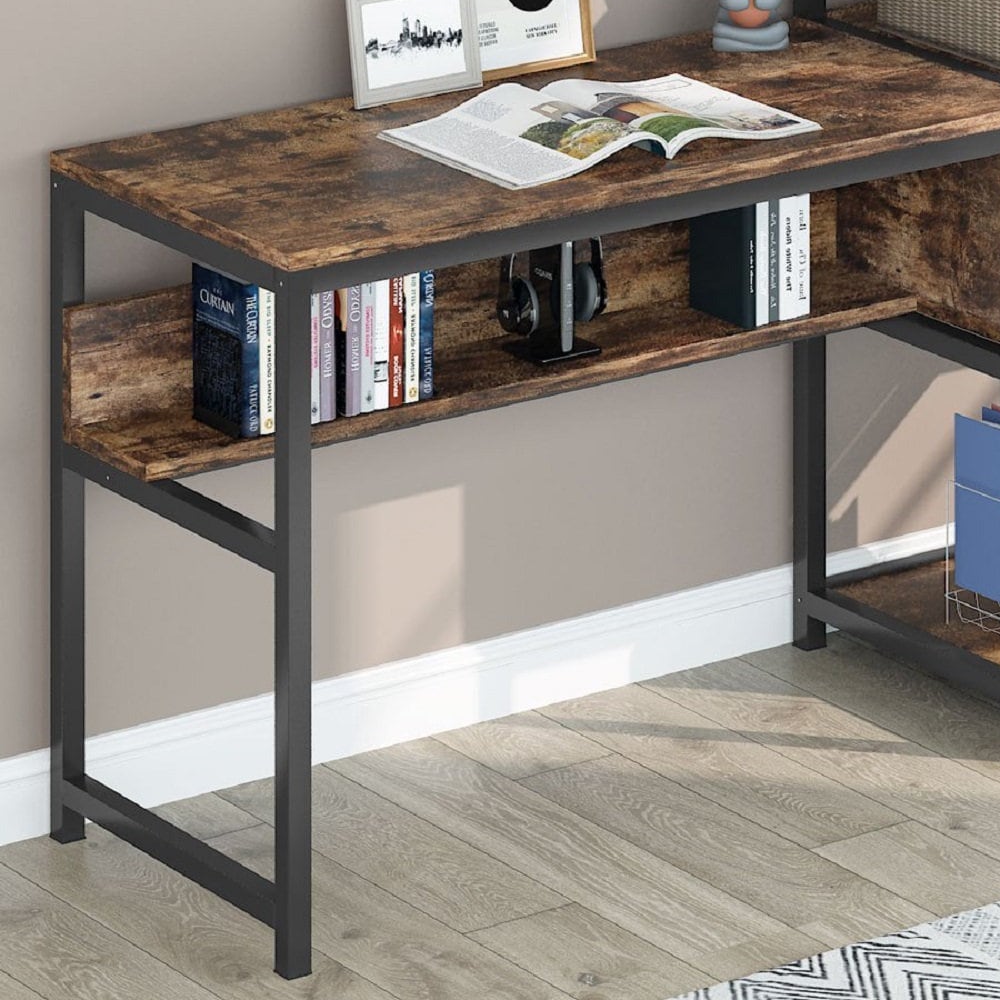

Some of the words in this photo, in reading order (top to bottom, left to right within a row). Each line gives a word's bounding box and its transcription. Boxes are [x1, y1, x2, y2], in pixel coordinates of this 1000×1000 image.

[200, 289, 234, 316] CURTAIN
[246, 294, 257, 310] THE
[321, 291, 333, 328] ODYS
[246, 310, 258, 343] CURTAIN
[323, 342, 332, 378] HOMER
